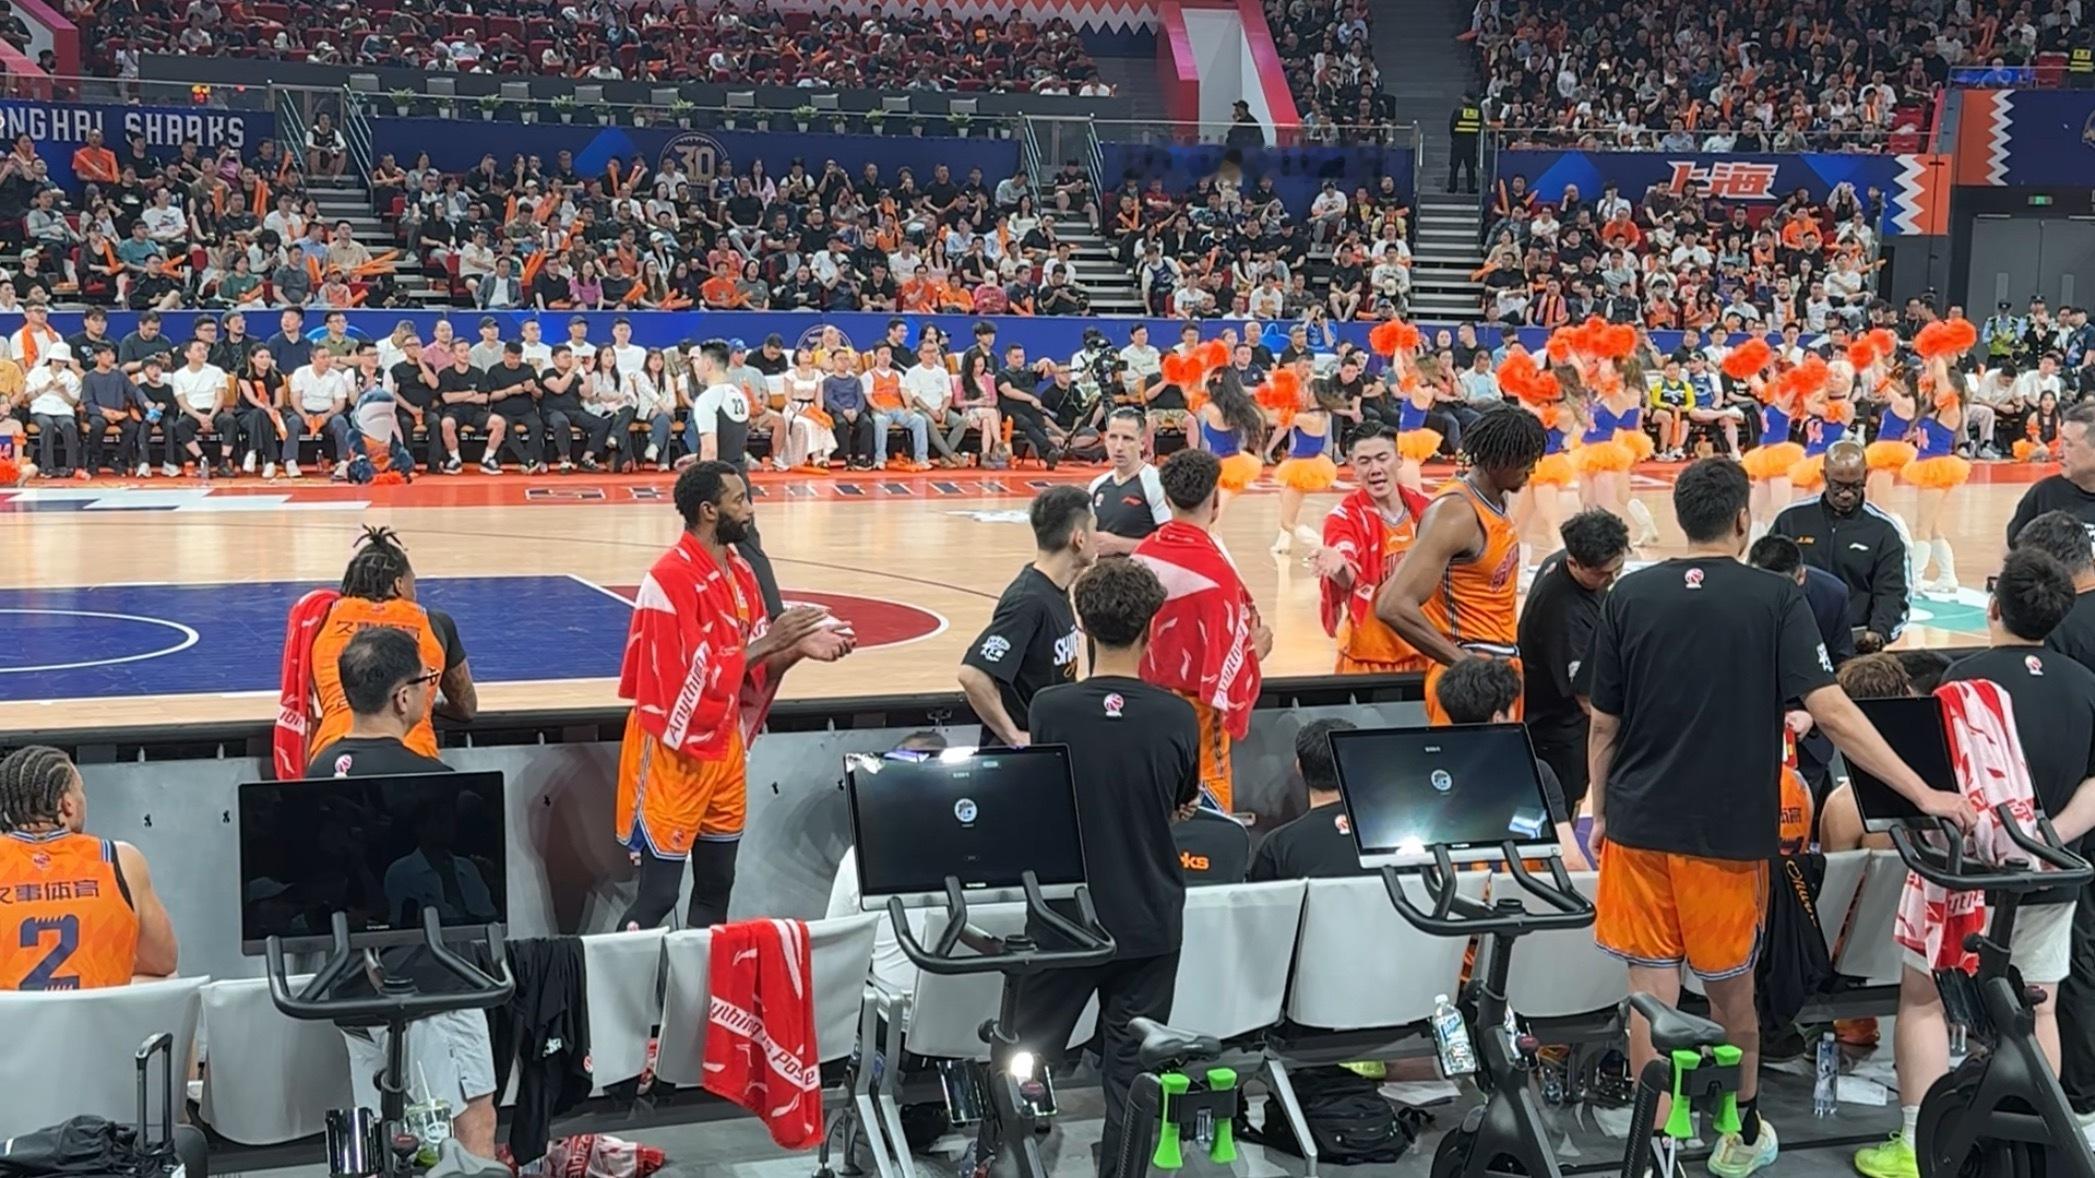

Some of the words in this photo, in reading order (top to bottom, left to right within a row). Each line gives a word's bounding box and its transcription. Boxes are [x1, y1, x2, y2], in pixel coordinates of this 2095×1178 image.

[674, 145, 716, 181] 30
[1645, 160, 1780, 200] 上海
[730, 397, 746, 416] 23
[18, 913, 81, 992] 2
